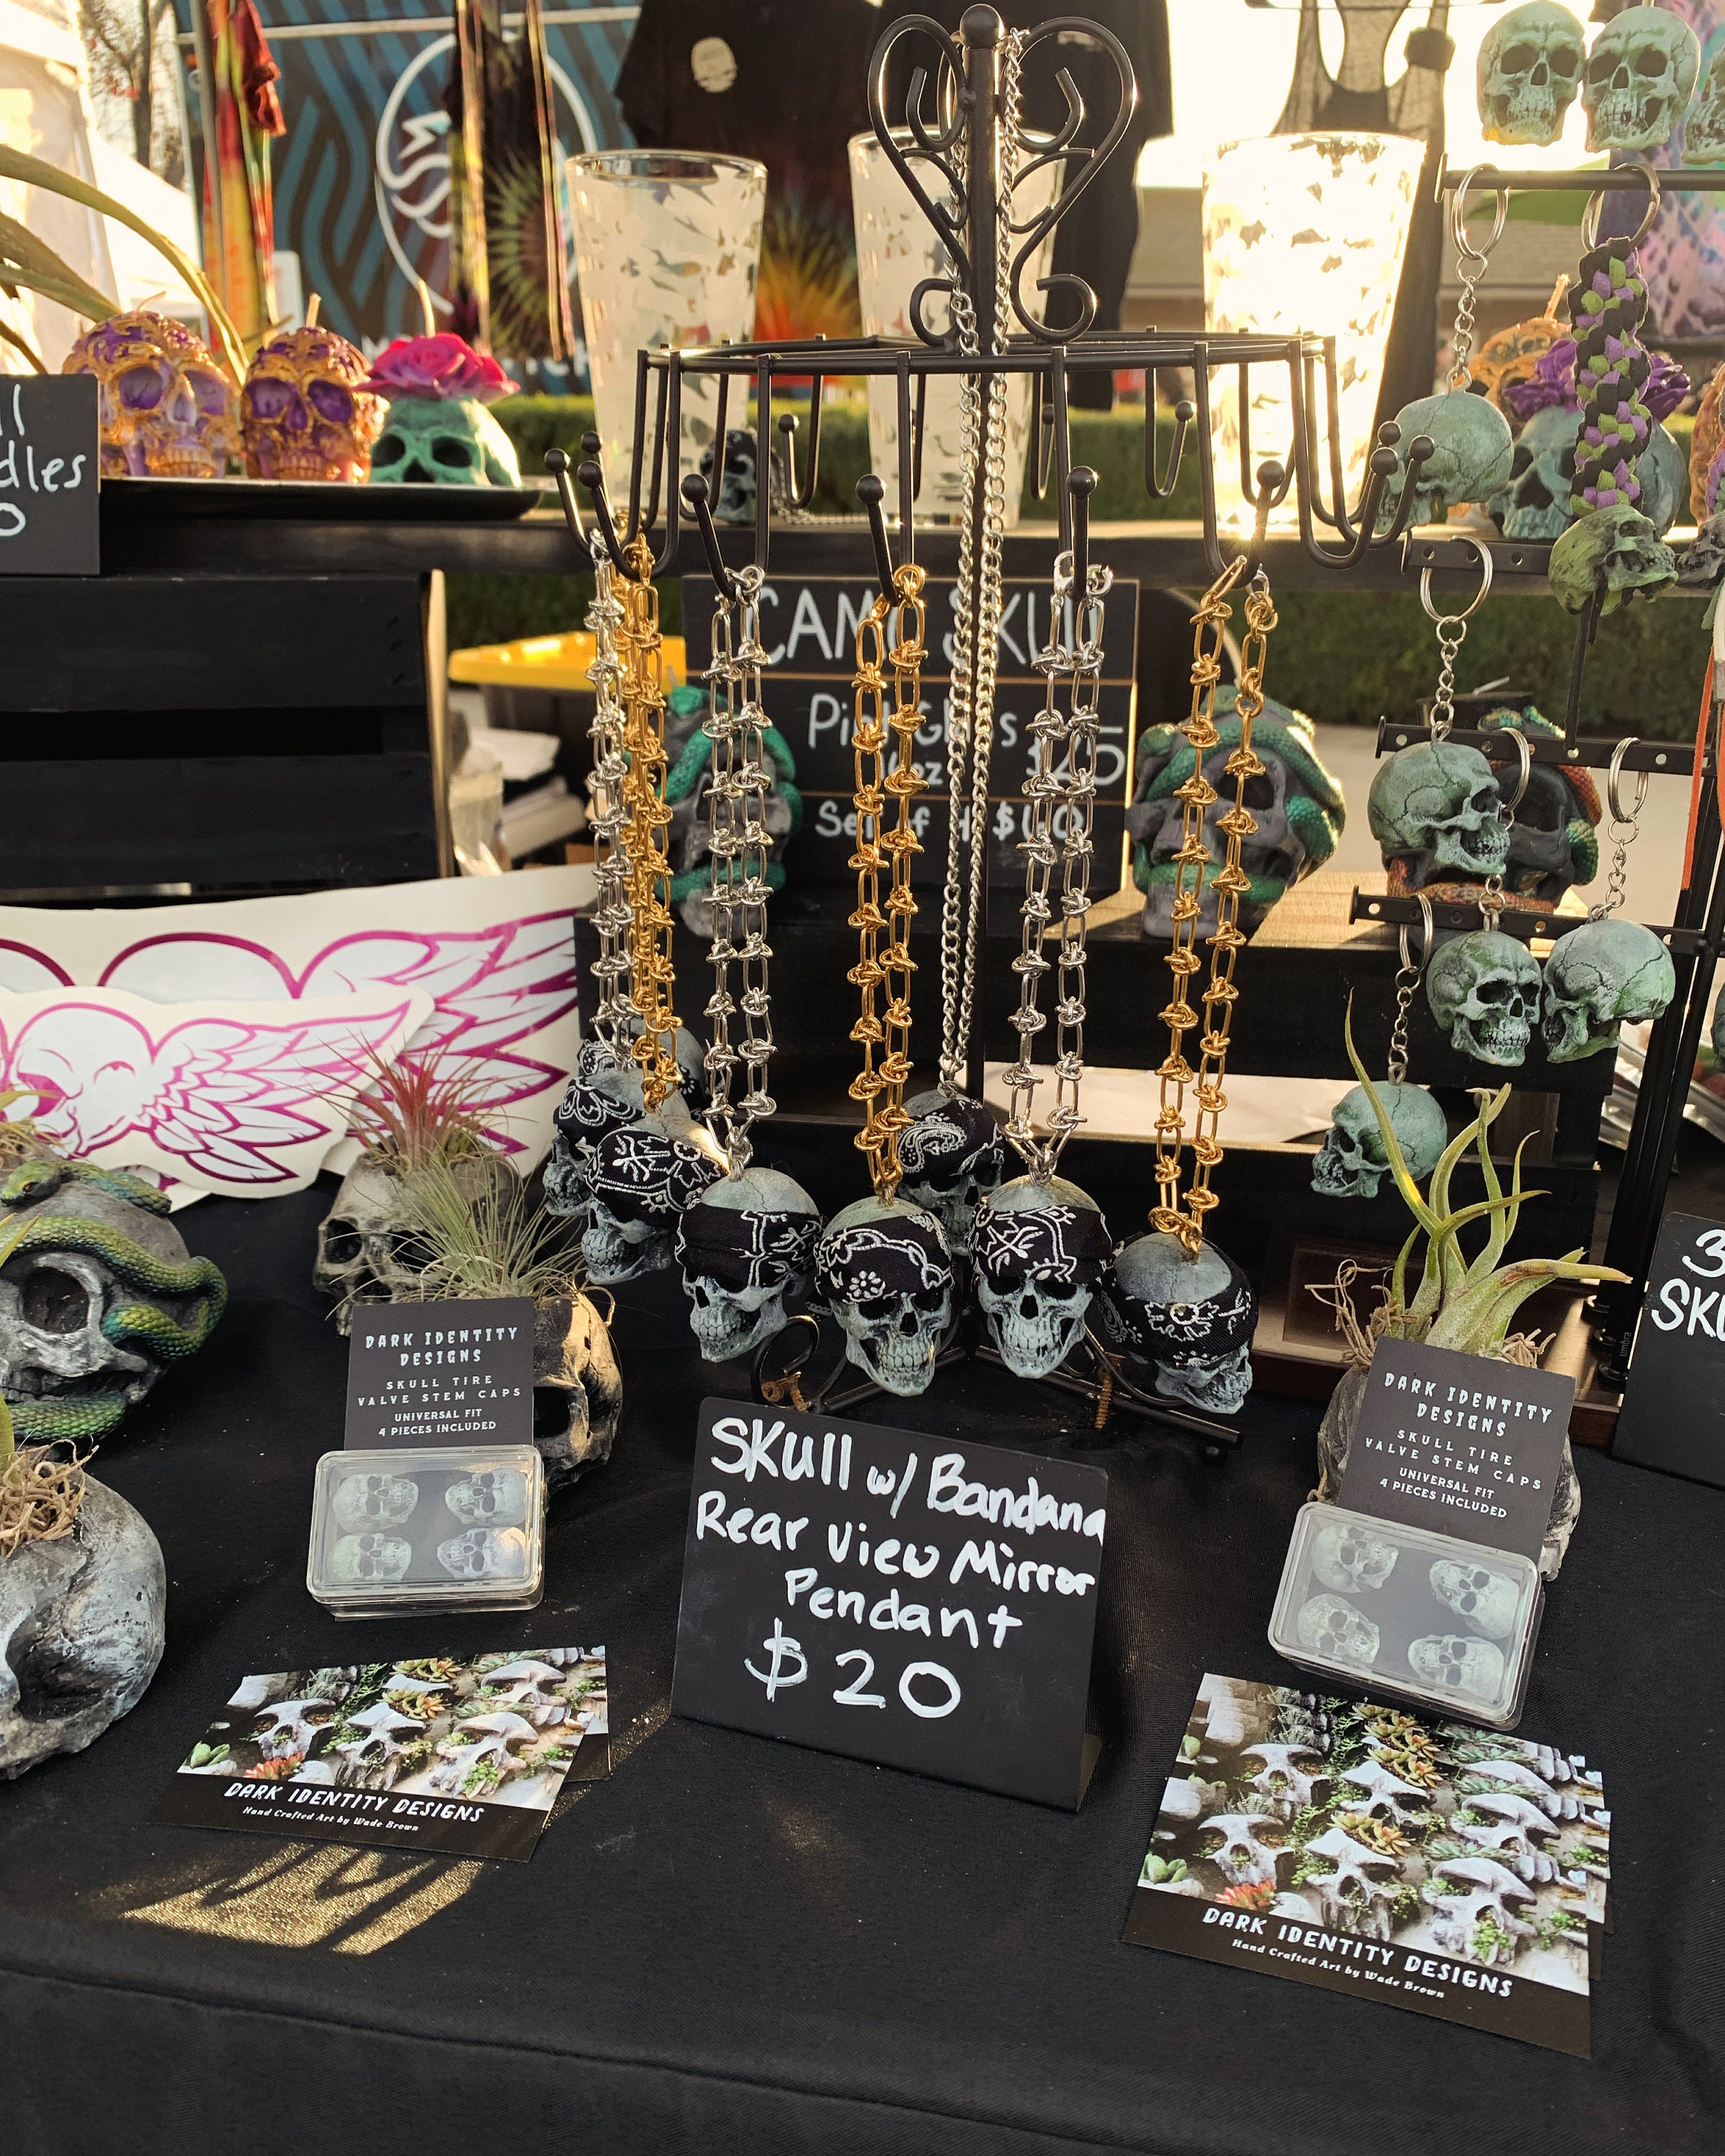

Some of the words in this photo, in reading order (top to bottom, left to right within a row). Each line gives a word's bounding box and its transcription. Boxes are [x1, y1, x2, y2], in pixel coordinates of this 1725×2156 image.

[914, 699, 1018, 748] Gls
[366, 1333, 413, 1348] DARK
[426, 1327, 517, 1345] IDENTITY
[1619, 1332, 1632, 1357] umbra
[400, 1349, 480, 1366] DESIGNS
[358, 1395, 409, 1406] VALVE
[422, 1391, 464, 1401] STEM
[478, 1388, 520, 1398] CAPS
[387, 1379, 439, 1389] SKULL
[453, 1376, 492, 1386] TIRE
[1385, 1373, 1436, 1396] DARK
[1448, 1387, 1552, 1423] IDENTITY
[391, 1425, 431, 1435] PIECES
[437, 1422, 496, 1432] INCLUDED
[395, 1410, 459, 1422] UNIVERSAL
[465, 1409, 482, 1417] FIT
[1417, 1403, 1506, 1437] DESIGNS
[1366, 1438, 1419, 1459] VALVE
[1432, 1455, 1479, 1474] STEM
[1494, 1470, 1540, 1489] CAPS
[1397, 1430, 1453, 1451] SKULL
[1469, 1447, 1512, 1465] TIRE
[927, 1455, 1105, 1546] Bandana
[1380, 1478, 1388, 1487] 4
[1392, 1481, 1436, 1499] PIECES
[1441, 1493, 1506, 1517] INCLUDED
[1400, 1468, 1468, 1493] UNIVERSAL
[1475, 1486, 1494, 1498] FIT
[696, 1491, 809, 1550] Rear
[949, 1540, 1095, 1595] Mirror
[785, 1568, 1022, 1648] Pendant
[224, 1783, 283, 1800] DARK
[288, 1789, 388, 1810] IDENTITY
[393, 1799, 484, 1822] DESIGNS
[243, 1807, 272, 1815] Hand
[275, 1810, 315, 1820] Crafted
[337, 1816, 349, 1825] by
[354, 1818, 382, 1827] Wade
[385, 1821, 418, 1830] Brown
[1202, 1908, 1266, 1935] DARK
[1278, 1925, 1394, 1965] IDENTITY
[1404, 1955, 1512, 1996] DESIGNS
[1232, 1939, 1266, 1953] Hand
[1269, 1948, 1316, 1965] Crafted
[1319, 1961, 1340, 1971] Art
[1345, 1966, 1360, 1978] by
[1365, 1971, 1399, 1986] Wade
[1404, 1981, 1444, 1998] Brown
